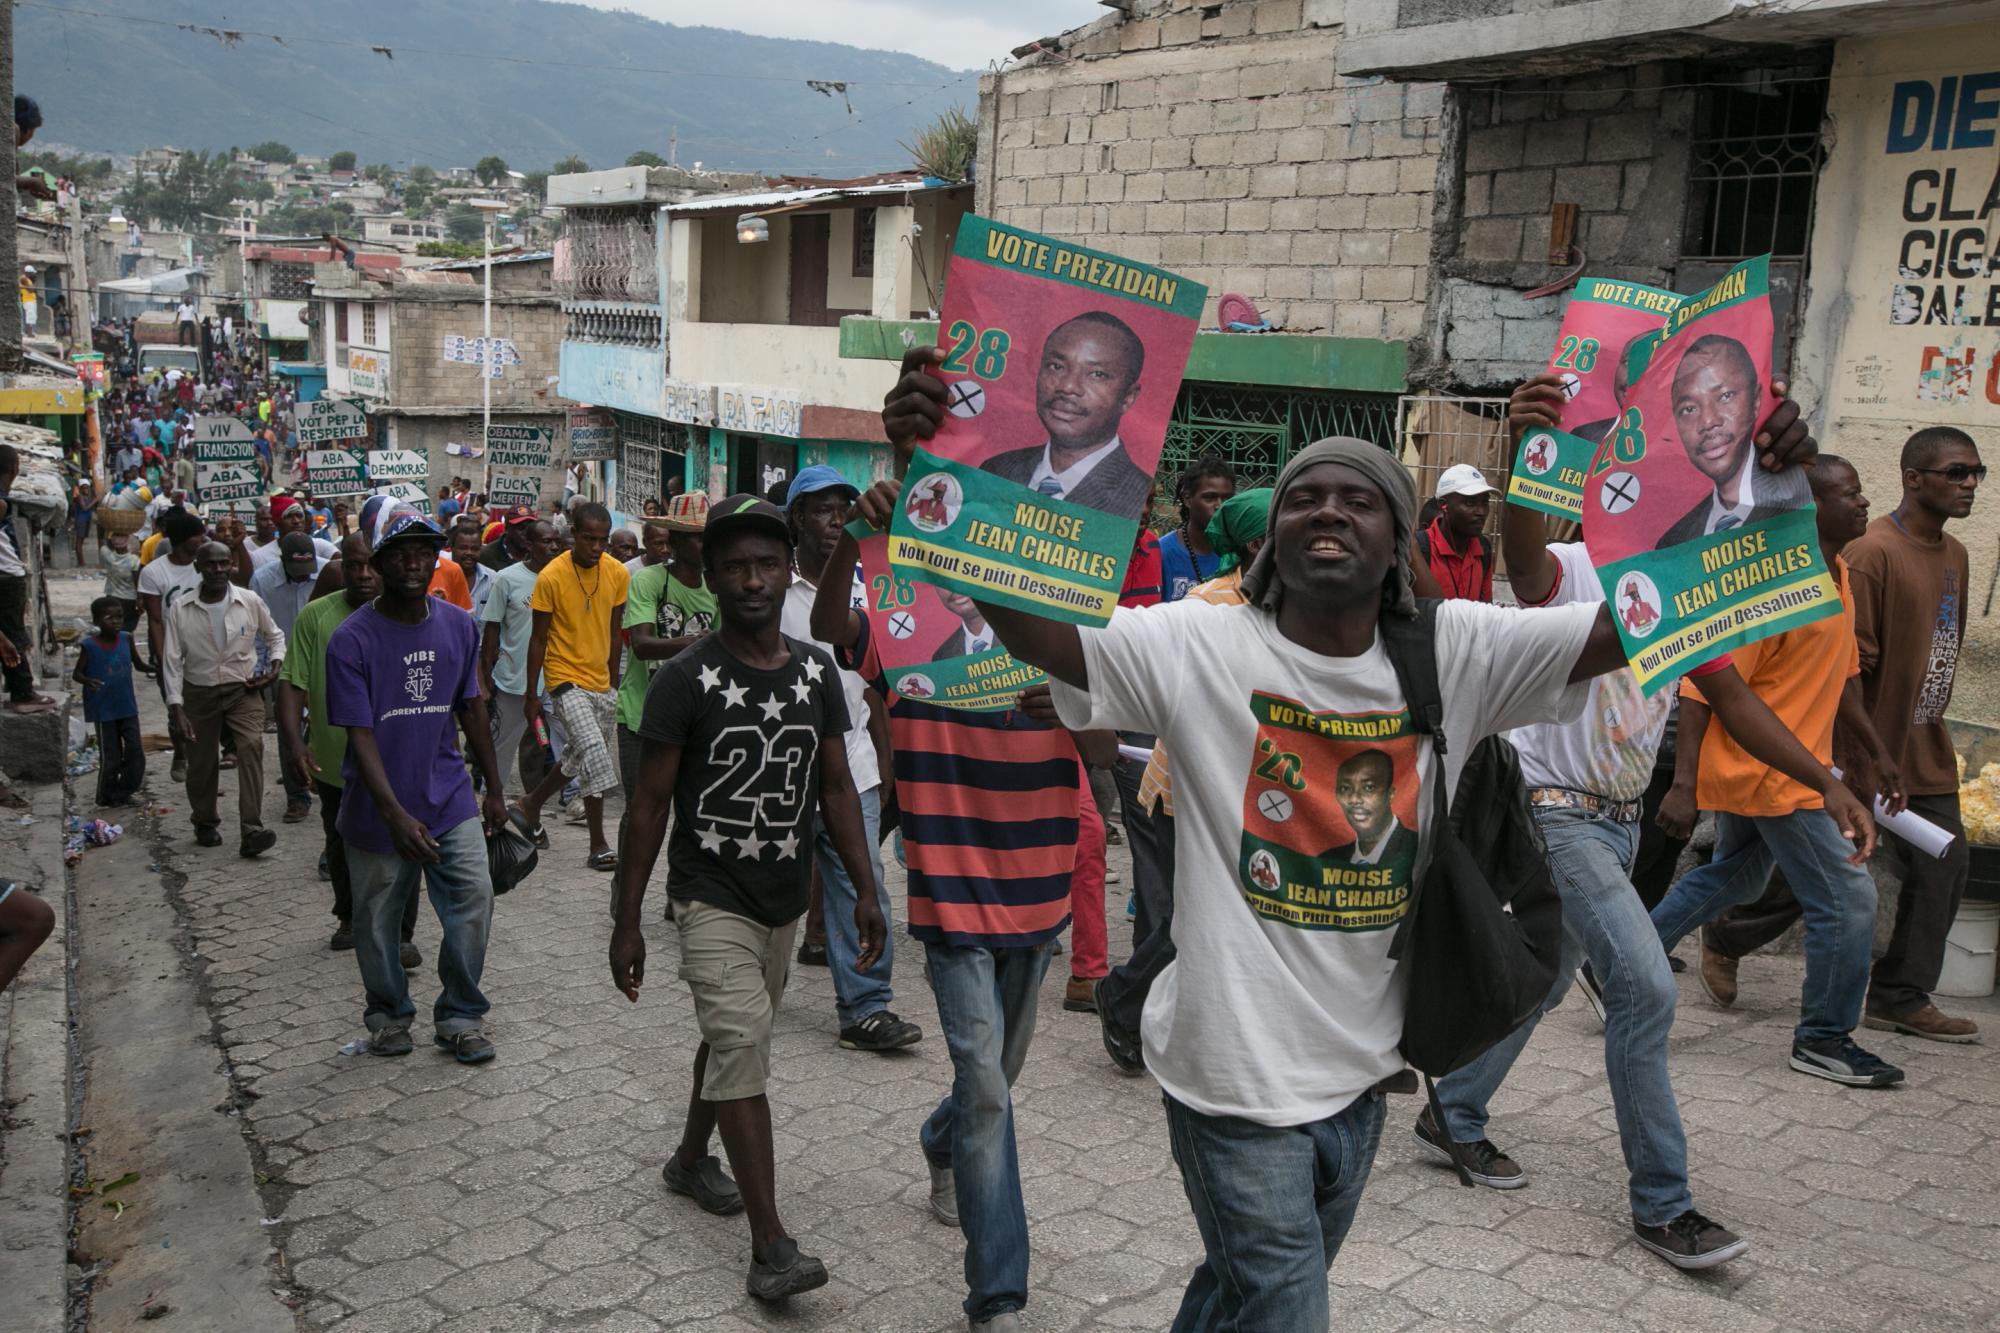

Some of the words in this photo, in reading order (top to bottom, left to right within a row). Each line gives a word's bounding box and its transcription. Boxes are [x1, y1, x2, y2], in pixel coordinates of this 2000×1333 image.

[987, 228, 1050, 271] VOTE
[1054, 248, 1178, 305] PREZIDAN
[1592, 282, 1633, 303] VOTE
[939, 319, 1011, 380] 28
[1552, 335, 1600, 374] 28
[353, 414, 366, 425] LA
[208, 423, 231, 437] VIV
[300, 425, 365, 440] RESPEKTE!
[488, 427, 531, 439] OBAMA
[196, 442, 255, 458] TRANZISYON
[488, 440, 508, 450] MEN
[321, 453, 345, 465] ABA
[381, 452, 404, 461] VIV
[210, 471, 242, 483] ABA
[310, 468, 359, 481] KOUDETA
[371, 463, 429, 476] DEMOKRASI
[200, 483, 259, 501] CEPHTK
[312, 480, 367, 495] ELEKTORAL
[389, 485, 410, 497] ABA
[495, 477, 531, 491] FUCK
[1517, 481, 1533, 494] Nou
[1533, 486, 1553, 500] tout
[1554, 493, 1567, 505] se
[1013, 502, 1085, 542] MOISE
[965, 519, 1018, 556] JEAN
[1020, 534, 1117, 580] CHARLES
[1701, 530, 1767, 574] MOISE
[898, 542, 925, 561] Nou
[928, 548, 959, 572] tout
[961, 561, 980, 578] se
[983, 567, 1016, 587] pitit
[1019, 575, 1104, 610] Dessalines
[1673, 579, 1718, 618] JEAN
[1720, 544, 1813, 597] CHARLES
[872, 575, 916, 612] 28
[1639, 653, 1661, 674] Nou
[1660, 638, 1686, 662] tout
[1688, 628, 1703, 647] se
[1705, 615, 1732, 640] pitit
[1734, 584, 1823, 626] Dessalines
[403, 650, 436, 666] VIBE
[967, 653, 1014, 678] MOISE
[946, 682, 978, 697] JEAN
[981, 665, 1044, 691] CHARLES
[1268, 704, 1316, 730] VOTE
[1319, 717, 1402, 737] PREZIDAN
[697, 724, 819, 828] 23
[1322, 868, 1393, 886] MOISE
[1287, 882, 1331, 906] JEAN
[1302, 911, 1330, 923] Pitit
[1333, 910, 1401, 926] Dessalines
